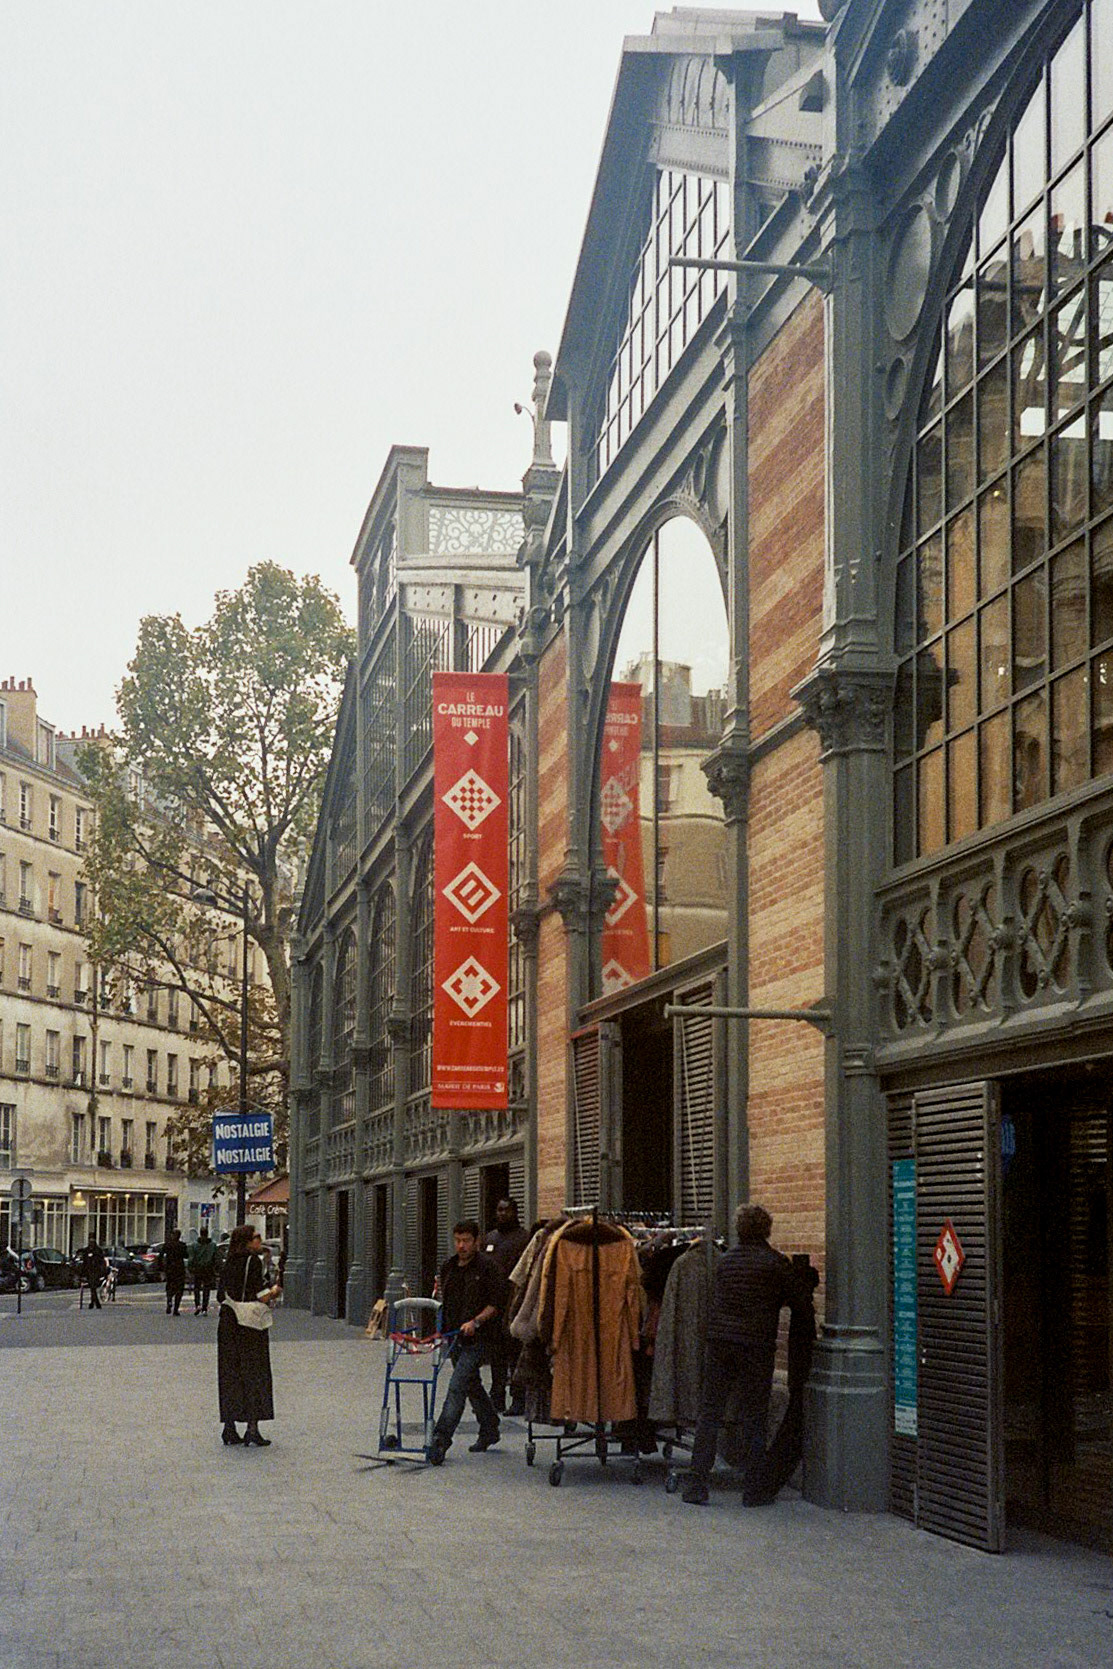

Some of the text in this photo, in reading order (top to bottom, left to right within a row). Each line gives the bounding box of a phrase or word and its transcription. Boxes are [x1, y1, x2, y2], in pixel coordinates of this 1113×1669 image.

[466, 692, 475, 702] LE
[437, 703, 504, 717] CARREAU
[451, 717, 491, 729] DU TEMPLE
[215, 1122, 270, 1140] NOSTALGIE
[217, 1147, 271, 1165] NOSTALGIE
[249, 1204, 266, 1214] Café
